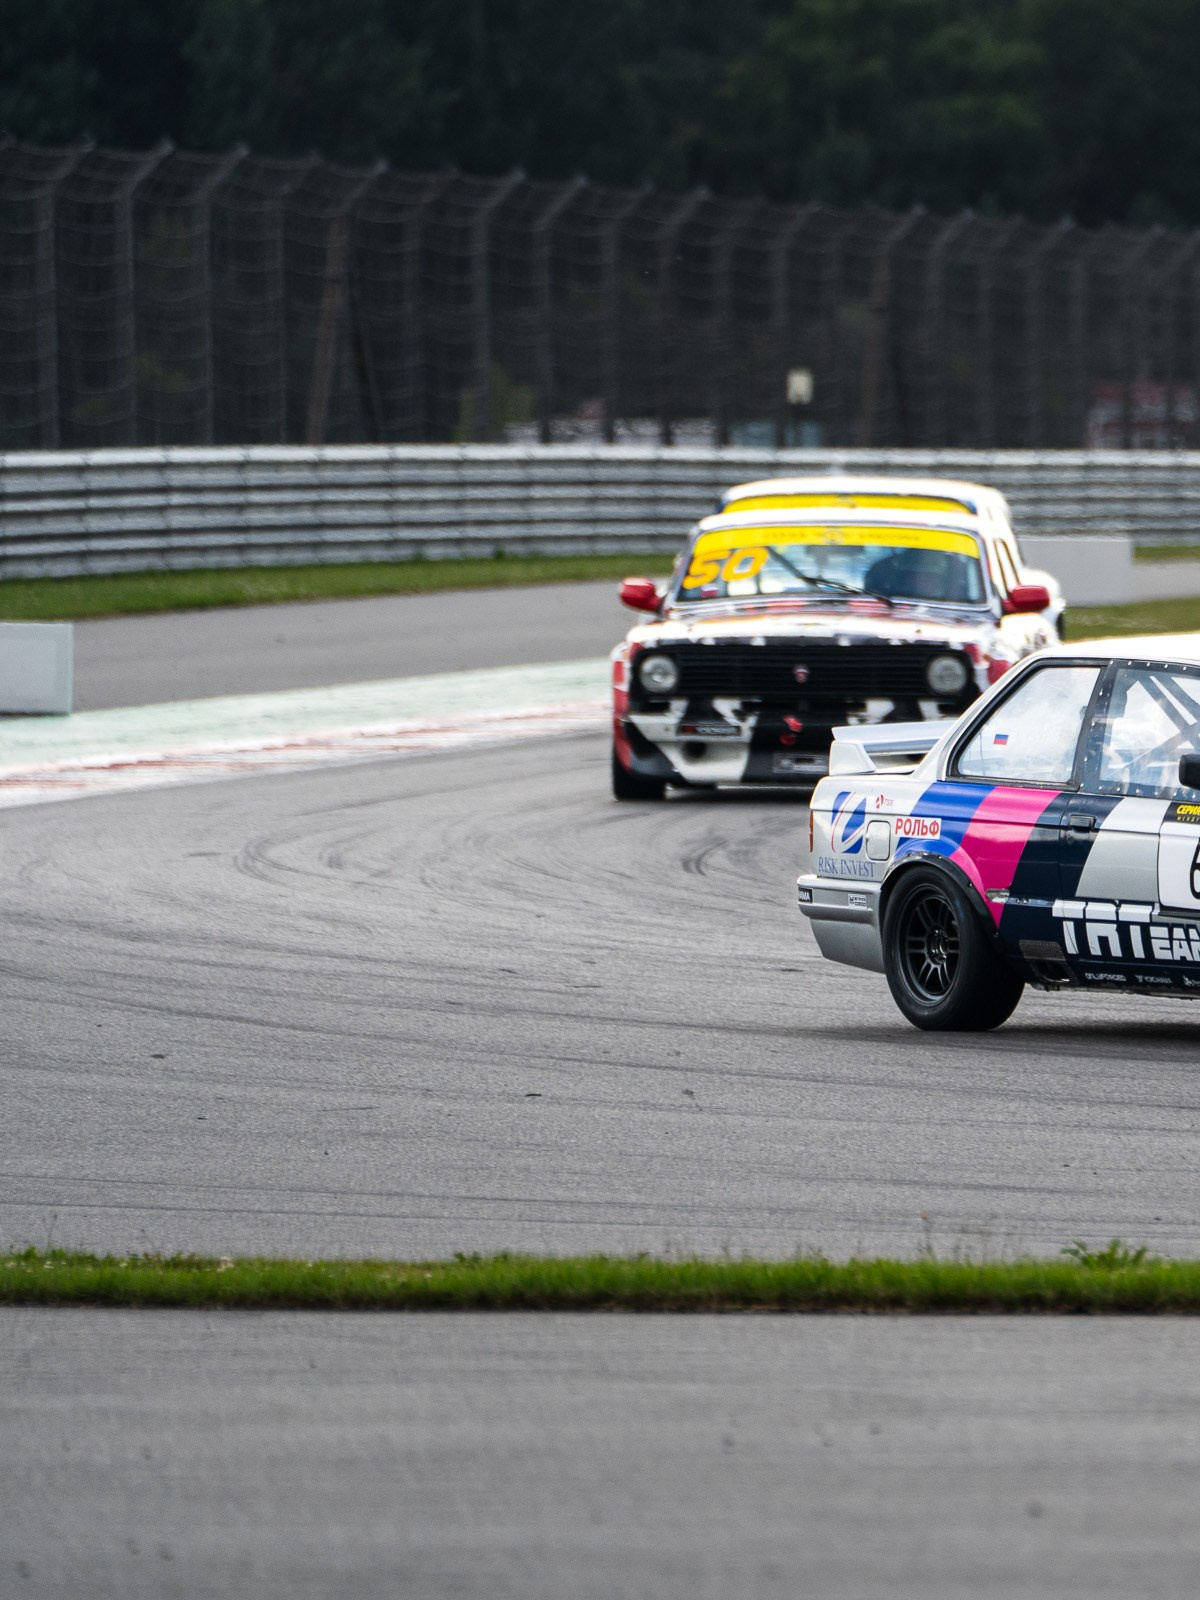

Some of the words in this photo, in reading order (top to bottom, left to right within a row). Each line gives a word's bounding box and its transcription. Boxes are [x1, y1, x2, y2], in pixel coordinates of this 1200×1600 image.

[682, 546, 770, 589] 50
[895, 818, 940, 837] РОЛЬФ
[818, 857, 838, 874] RISK
[840, 860, 876, 877] INVEST
